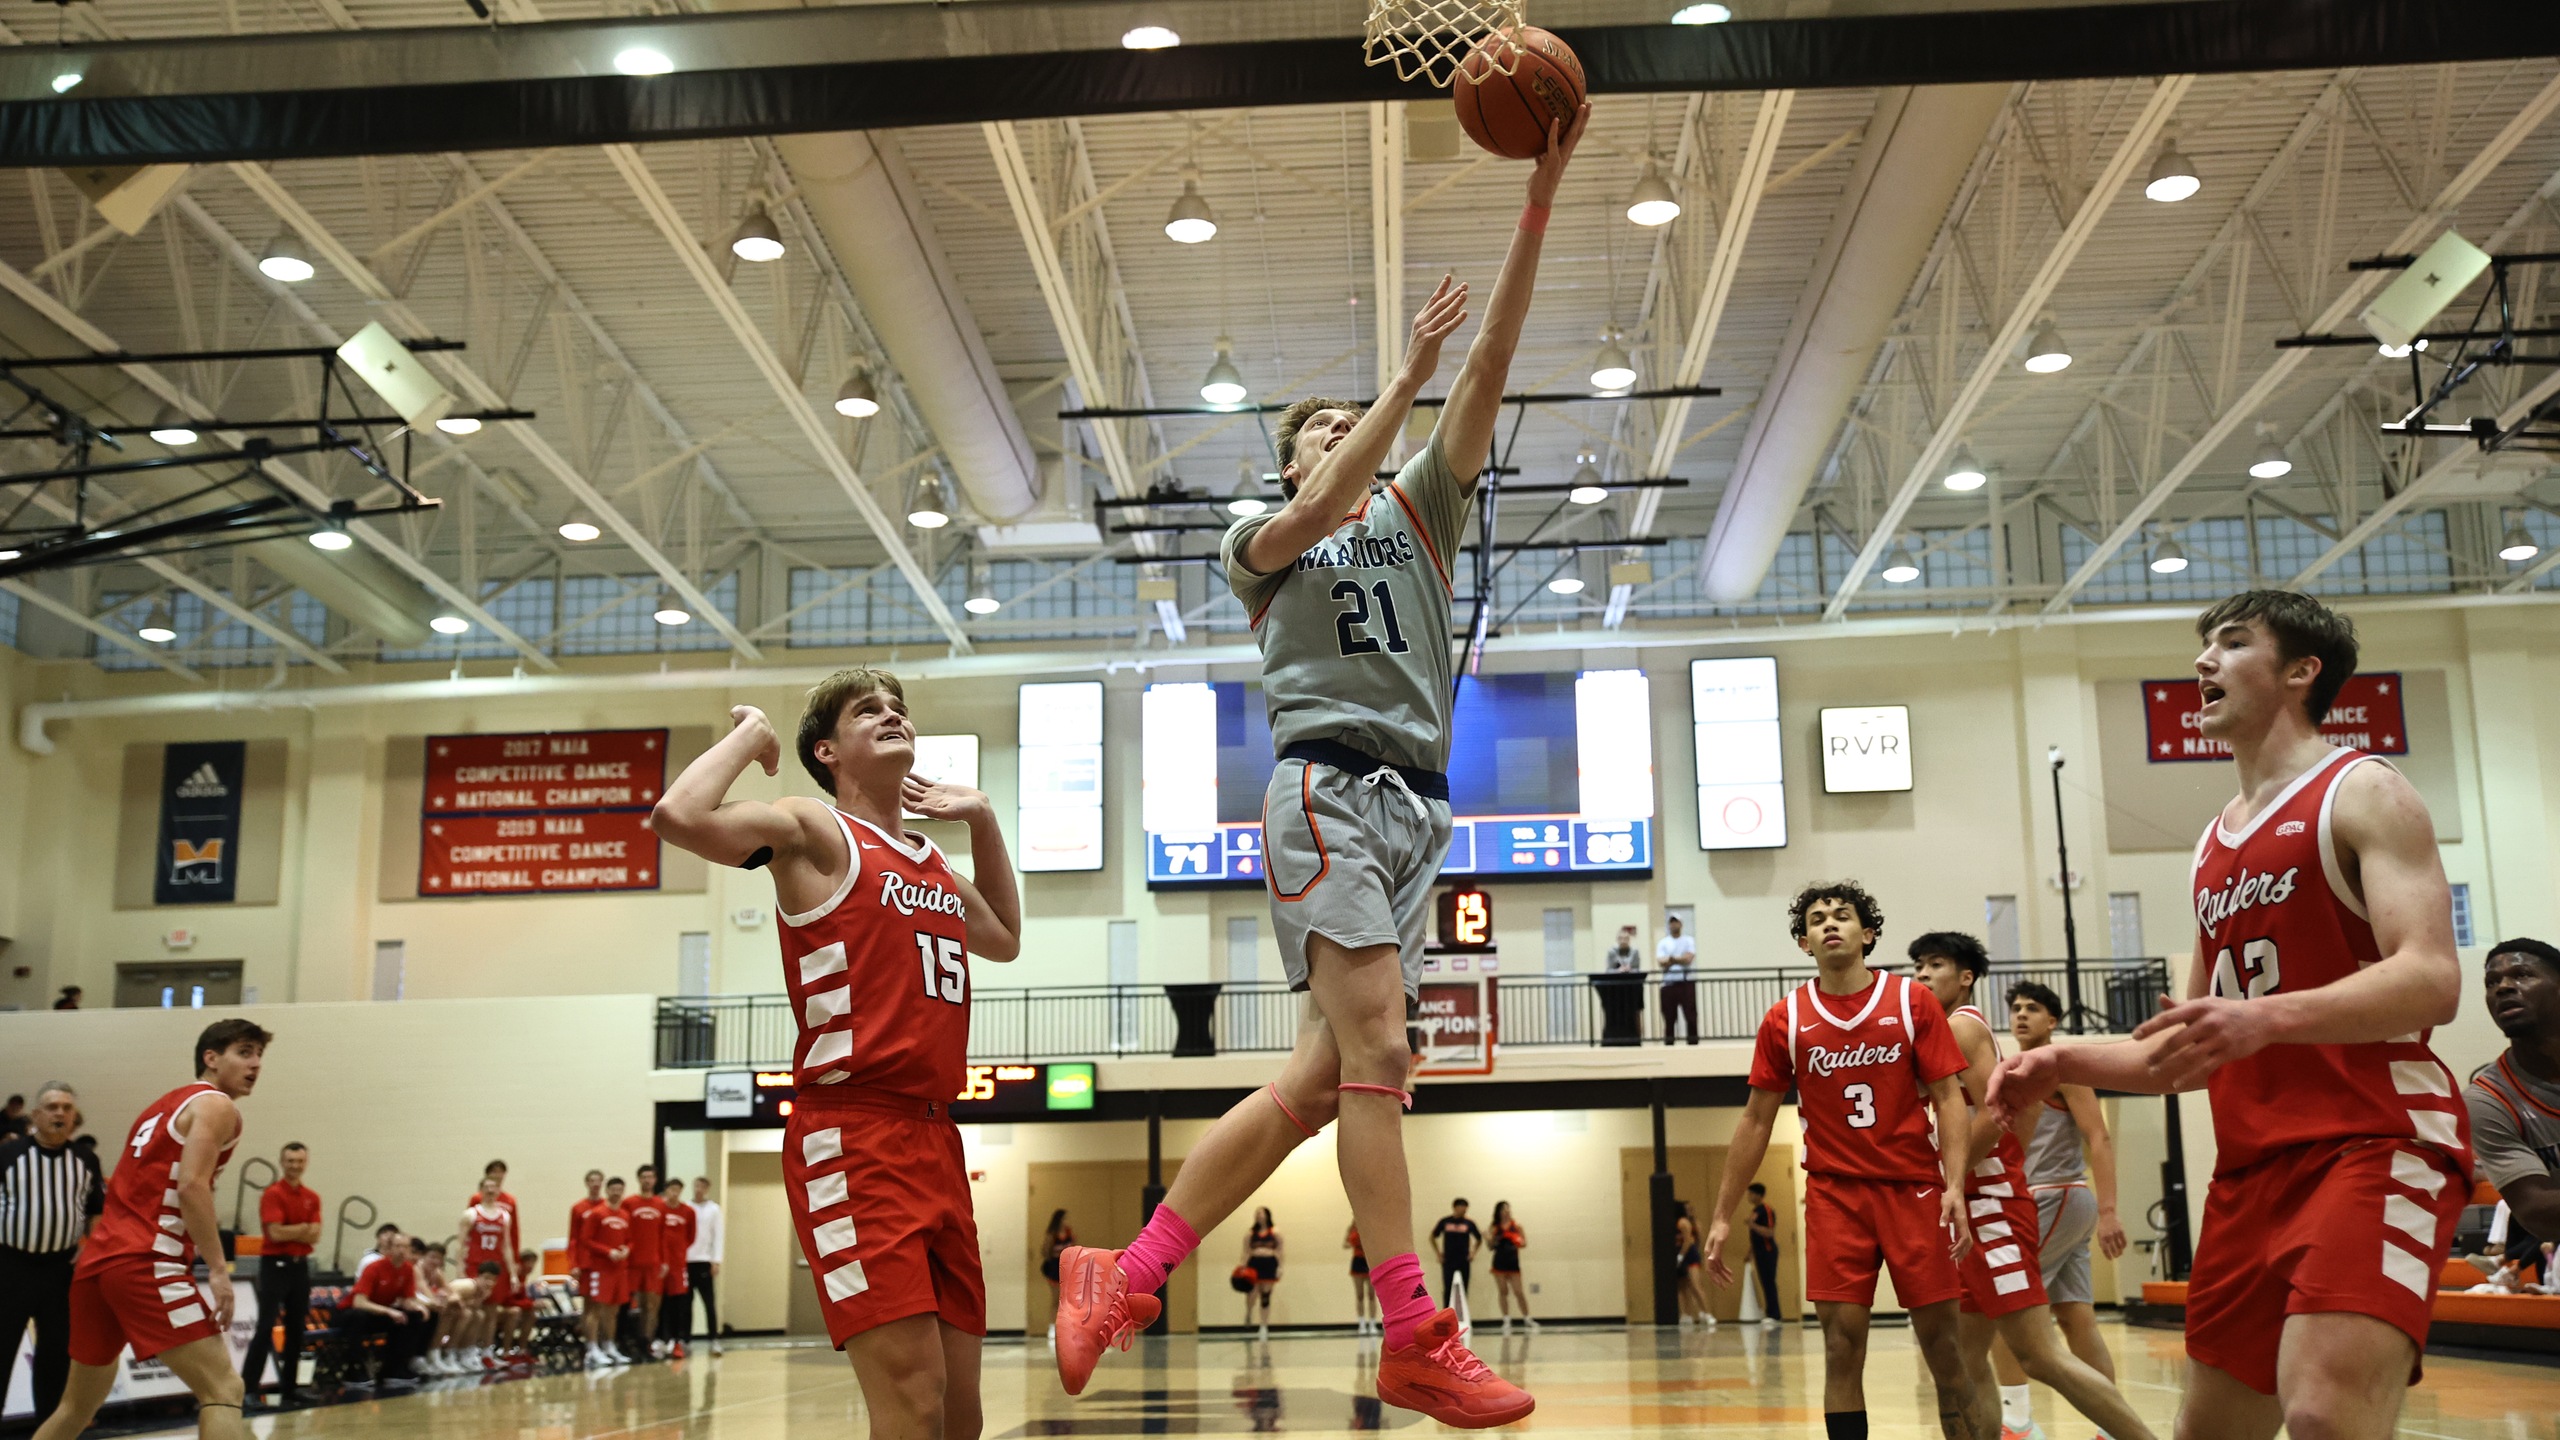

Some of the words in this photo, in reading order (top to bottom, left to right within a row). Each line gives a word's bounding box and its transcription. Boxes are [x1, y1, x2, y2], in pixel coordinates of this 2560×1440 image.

[1297, 529, 1415, 573] WARRIORS
[1329, 579, 1411, 658] 21
[2321, 705, 2368, 724] ANCE
[503, 740, 542, 757] 2017
[551, 738, 589, 755] NAIA
[2183, 738, 2232, 755] NATIO
[2321, 732, 2370, 750] PION
[455, 763, 567, 784] COMPETITIVE
[574, 762, 631, 780] DANCE
[455, 790, 538, 808] NATIONAL
[546, 787, 631, 805] CHAMPION
[497, 819, 537, 837] 2019
[544, 818, 584, 835] NAIA
[450, 843, 562, 863] COMPETITIVE
[569, 841, 627, 860] DANCE
[1164, 844, 1208, 874] 71
[450, 870, 534, 889] NATIONAL
[541, 867, 628, 885] CHAMPION
[2196, 867, 2298, 939] Raiders
[1456, 908, 1487, 943] 12
[914, 930, 965, 1006] 15
[1419, 1000, 1455, 1014] ANCE
[1807, 1042, 1902, 1077] Raiders
[1843, 1083, 1876, 1128] 3
